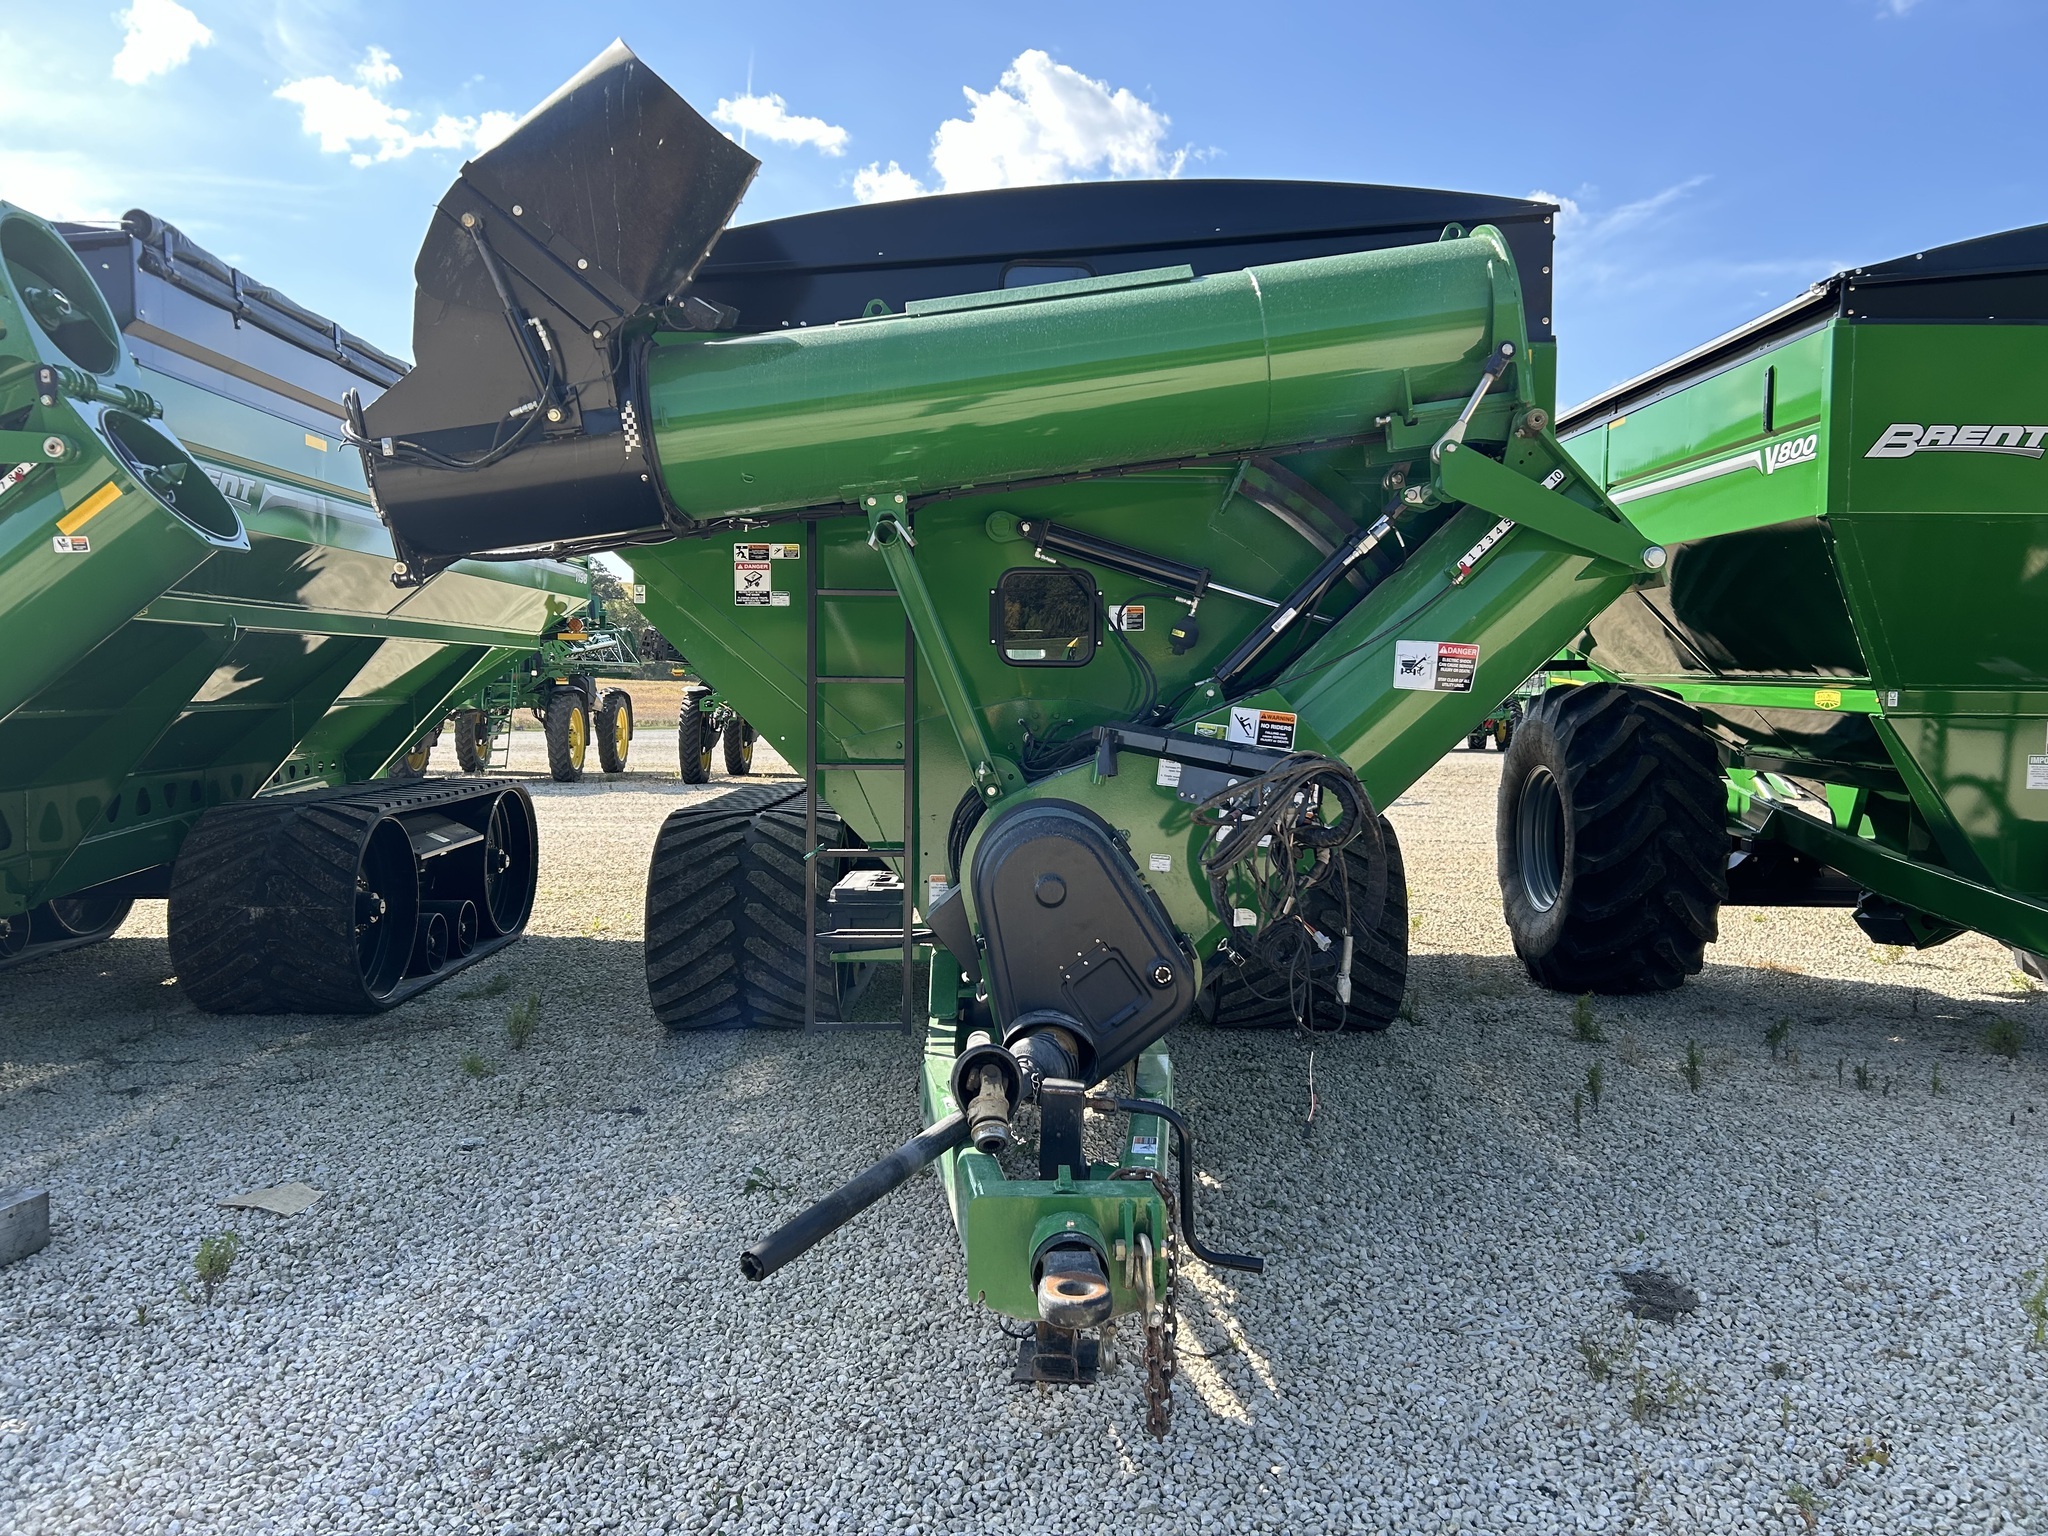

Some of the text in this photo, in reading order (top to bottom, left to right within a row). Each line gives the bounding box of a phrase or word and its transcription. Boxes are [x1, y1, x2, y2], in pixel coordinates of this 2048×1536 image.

[1765, 434, 1818, 475] V800
[1863, 423, 2048, 459] BRENT
[1550, 471, 1562, 484] 10
[1468, 553, 1476, 561] 1
[1477, 544, 1485, 552] 2
[1486, 535, 1494, 544] 3
[1496, 527, 1503, 535] 4
[1504, 518, 1512, 527] 5
[1448, 647, 1476, 655] DANGER
